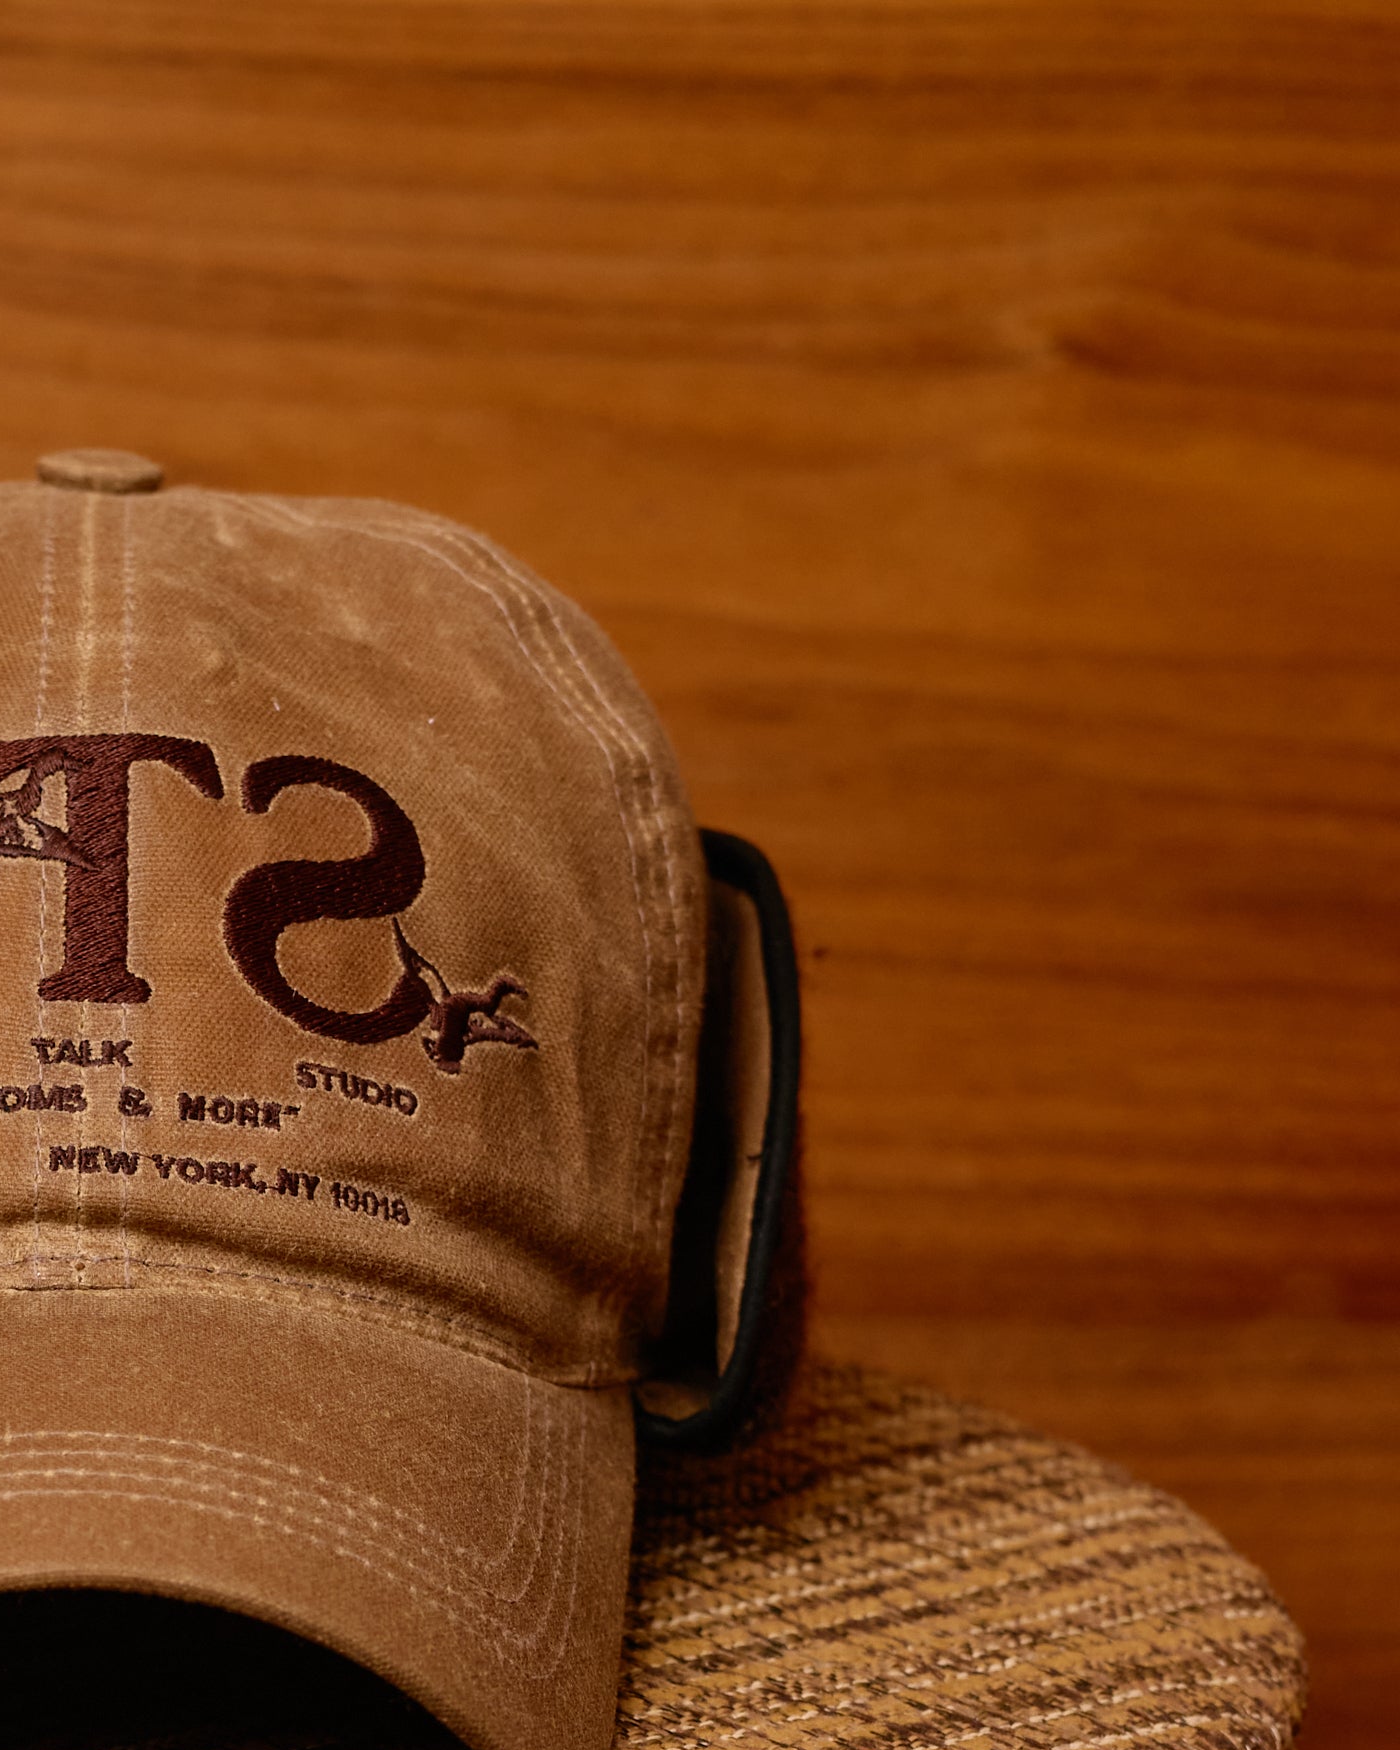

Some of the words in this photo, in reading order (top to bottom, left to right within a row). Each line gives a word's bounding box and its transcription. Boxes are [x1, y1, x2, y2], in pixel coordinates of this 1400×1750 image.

[31, 1037, 132, 1067] TALK
[295, 1060, 418, 1116] STUDIO
[117, 1086, 151, 1117] &
[50, 1145, 140, 1175] NEW
[152, 1154, 267, 1194] YORK,
[276, 1167, 320, 1200] NY
[330, 1182, 411, 1226] 10018
